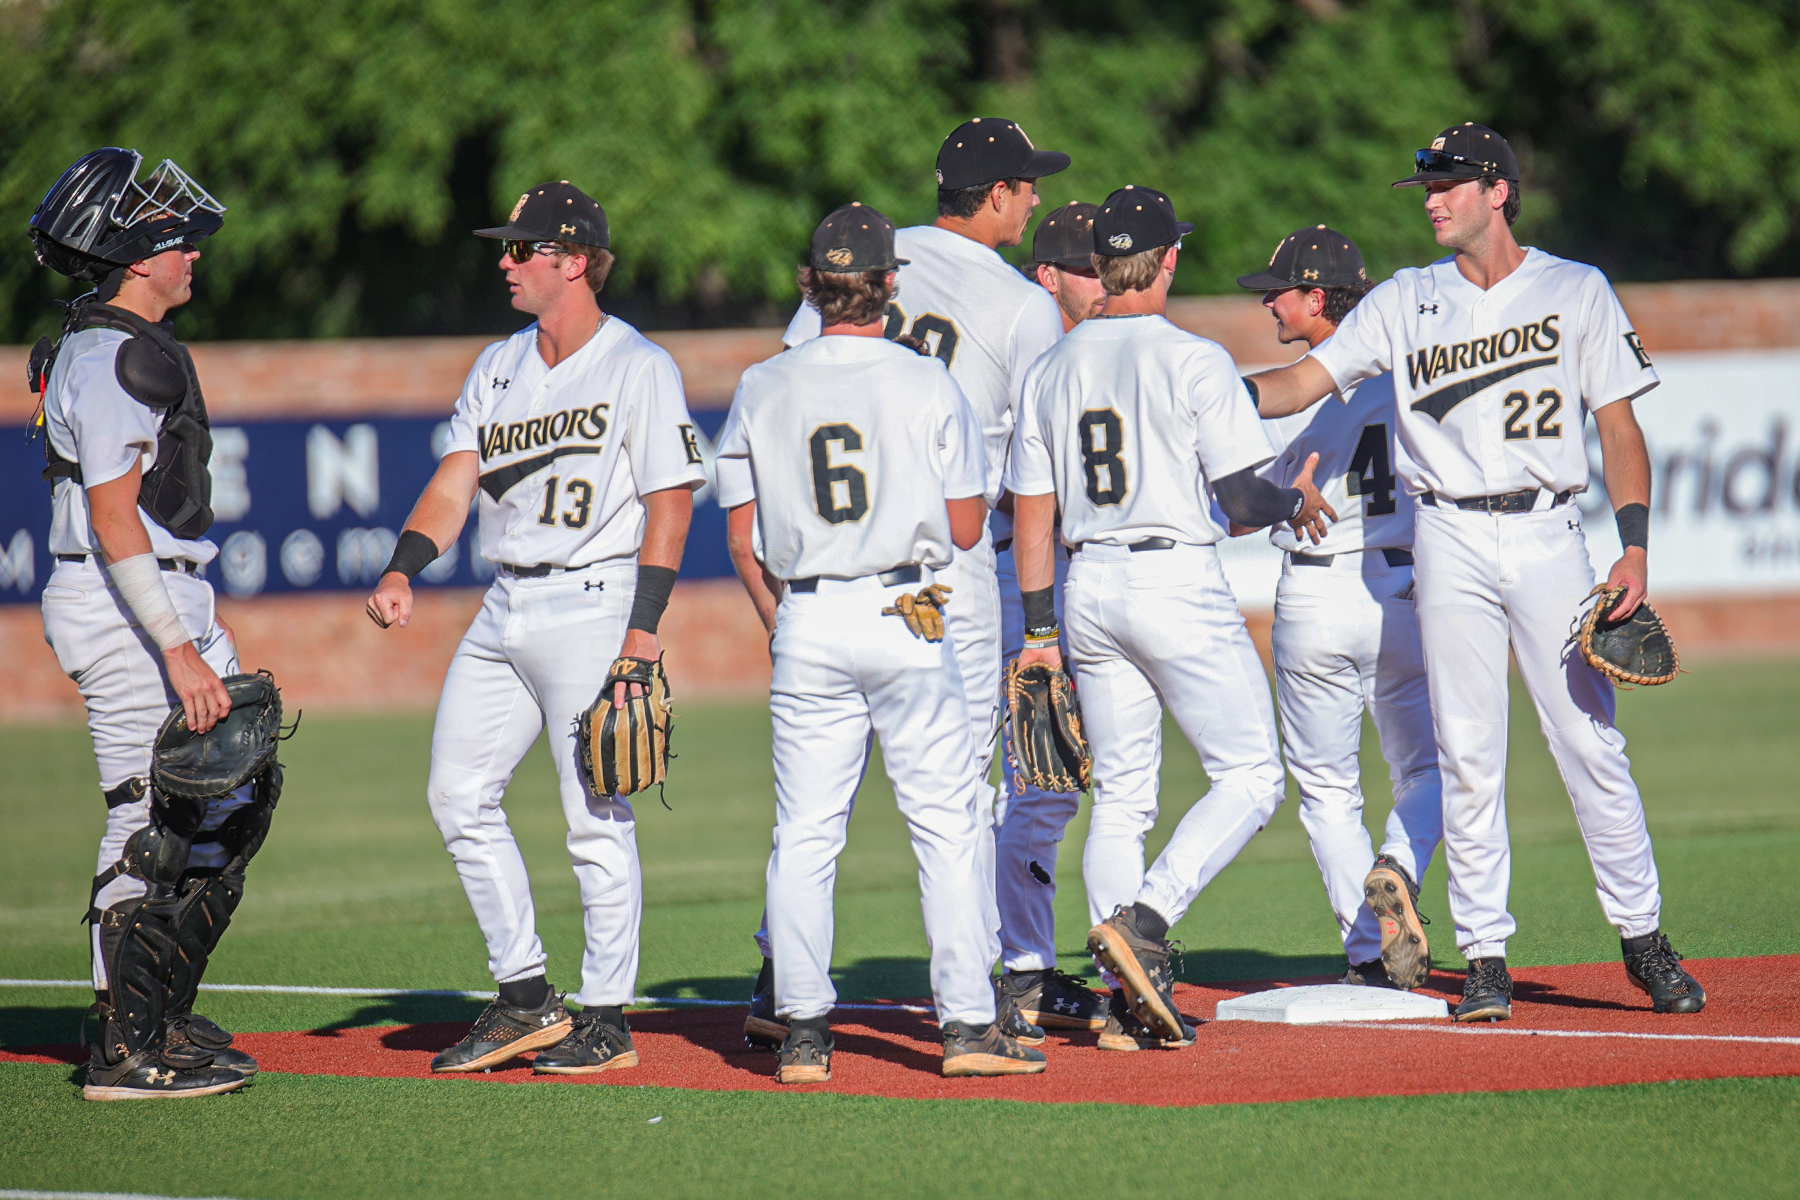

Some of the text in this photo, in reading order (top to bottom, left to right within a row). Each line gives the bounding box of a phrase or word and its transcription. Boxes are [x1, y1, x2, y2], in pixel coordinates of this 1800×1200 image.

[1406, 314, 1561, 391] WARRIORS
[1079, 406, 1129, 507] 8
[1503, 388, 1563, 441] 22
[537, 475, 595, 531] 13
[808, 422, 871, 526] 6
[1346, 422, 1397, 518] 4
